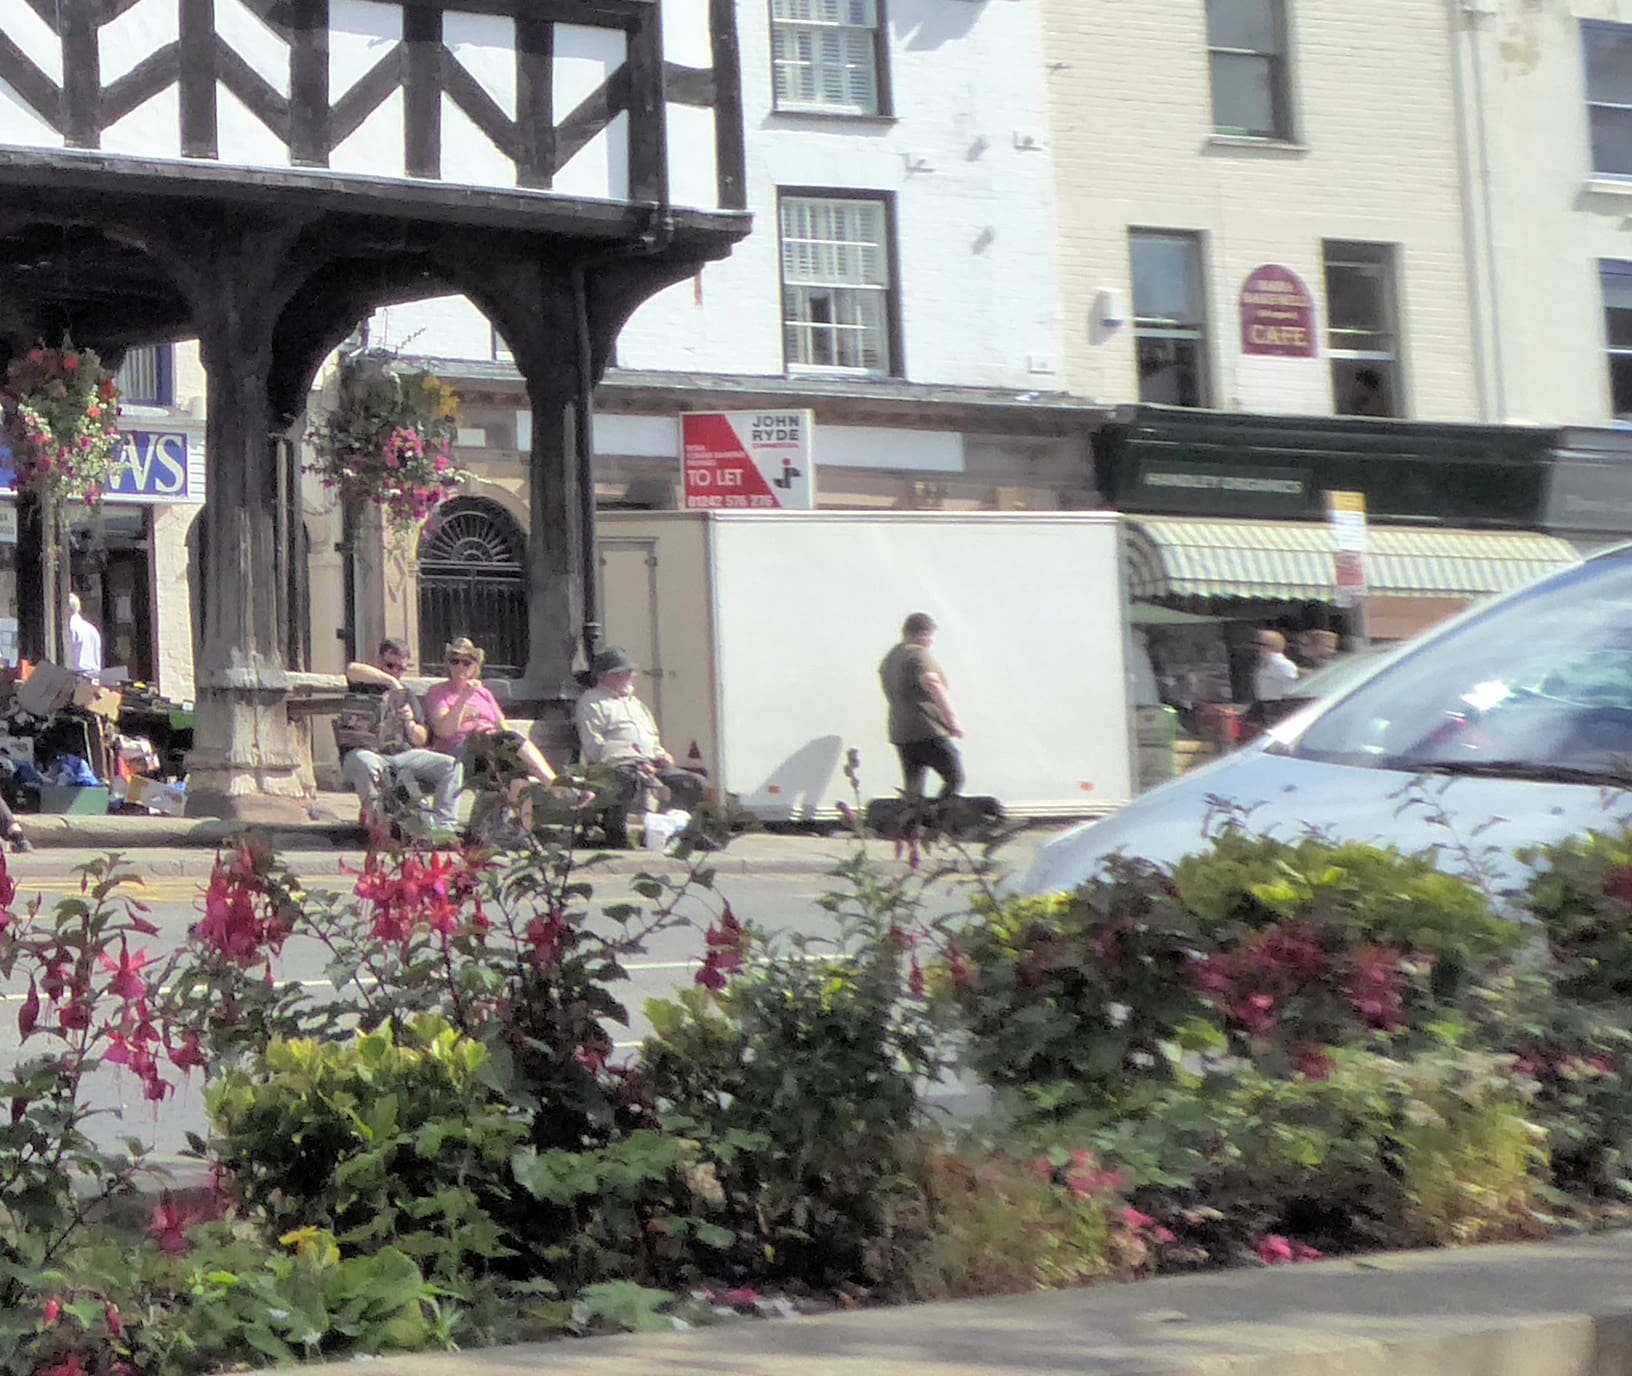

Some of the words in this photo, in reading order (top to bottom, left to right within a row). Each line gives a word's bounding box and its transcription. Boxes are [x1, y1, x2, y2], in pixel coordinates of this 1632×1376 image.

[752, 415, 799, 428] JOHN
[752, 429, 799, 441] RYDE
[687, 469, 711, 487] TO
[716, 468, 744, 487] LET
